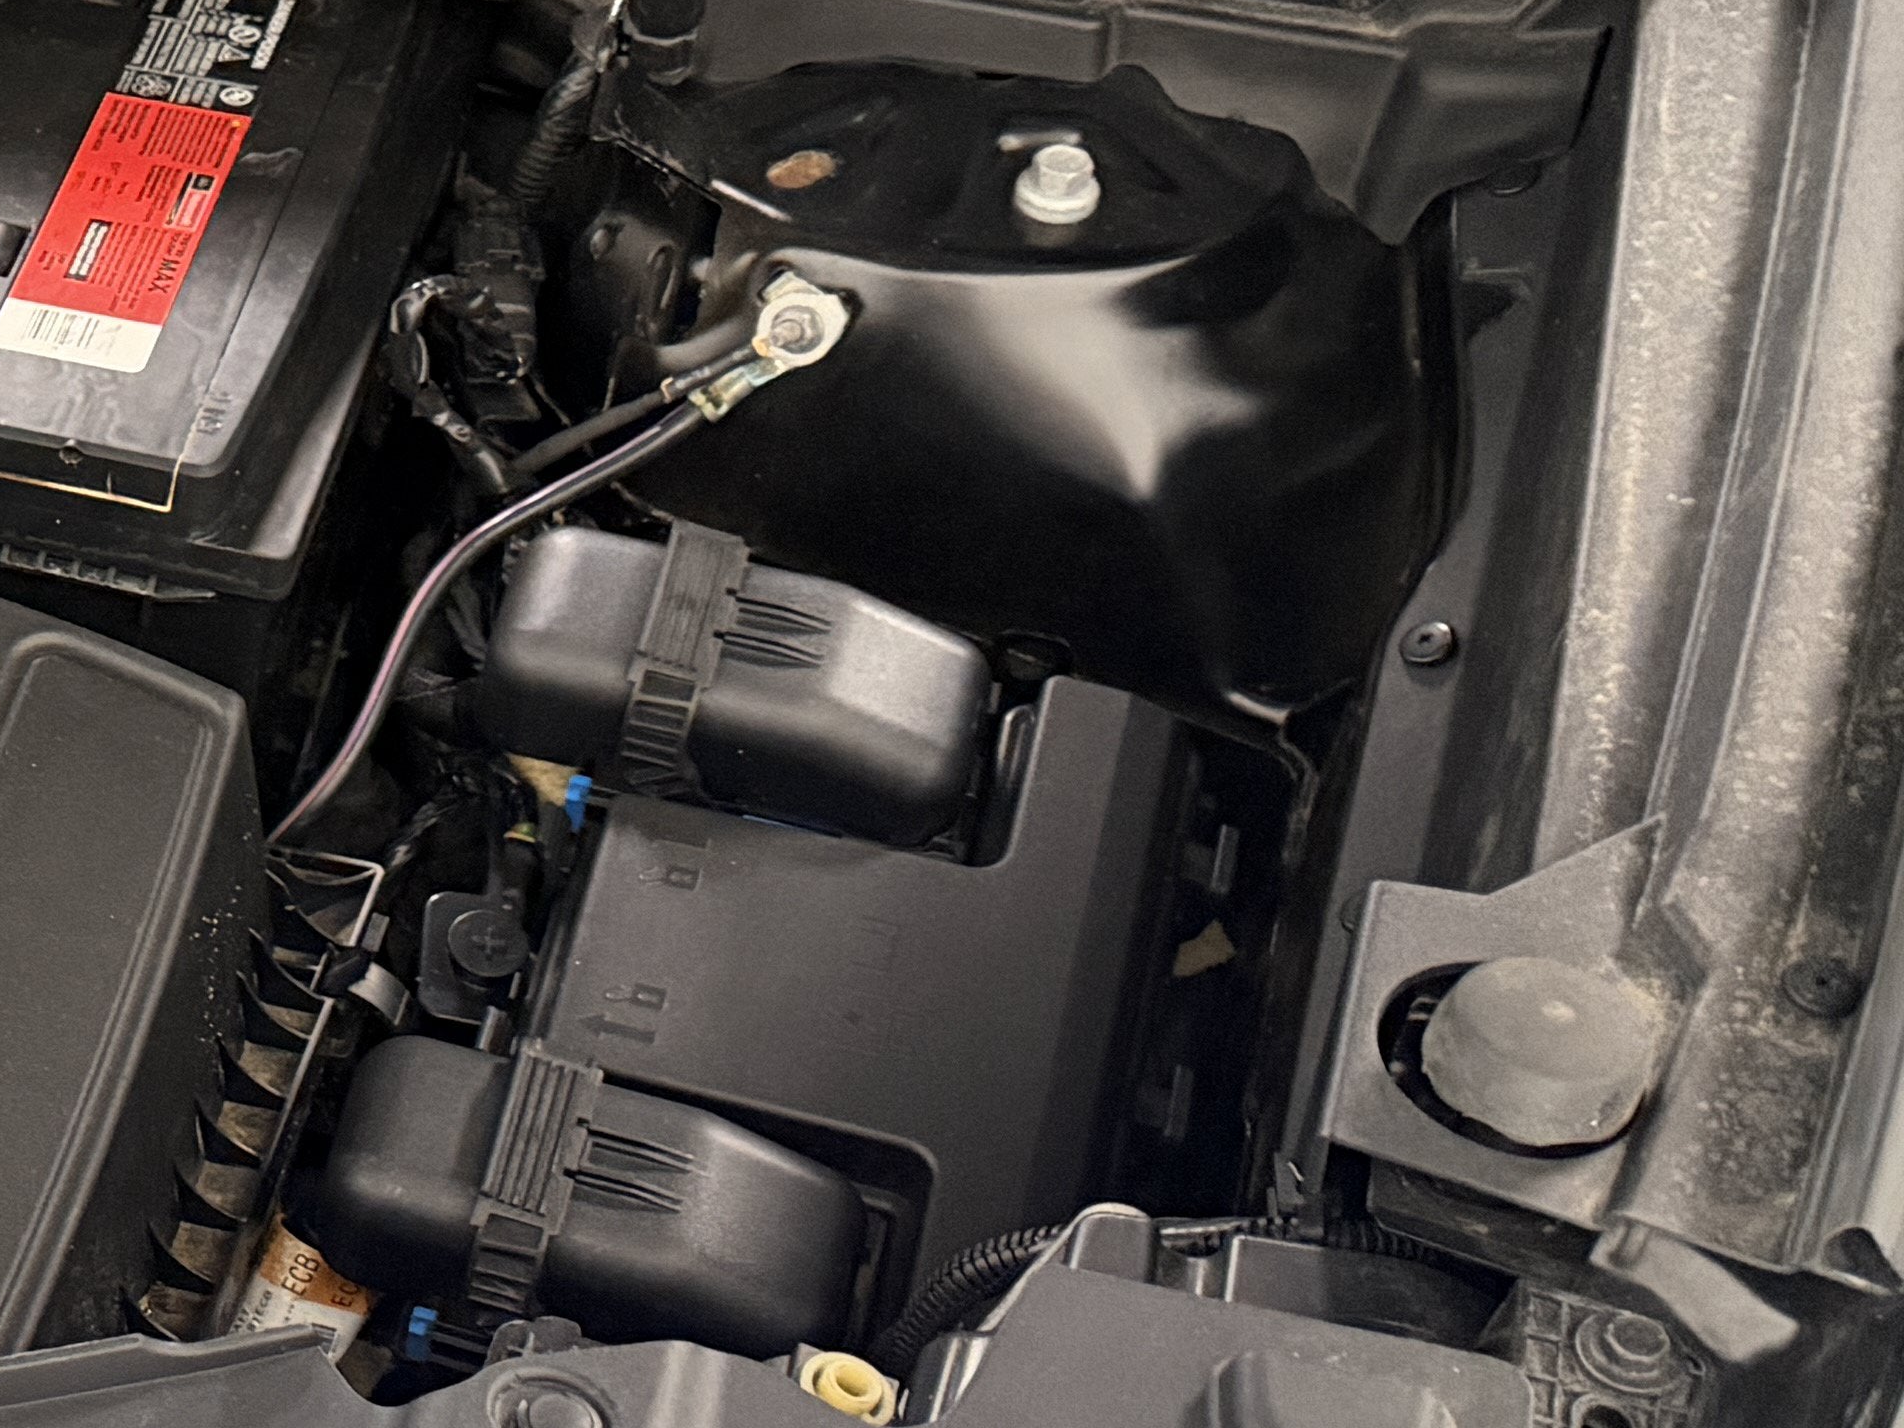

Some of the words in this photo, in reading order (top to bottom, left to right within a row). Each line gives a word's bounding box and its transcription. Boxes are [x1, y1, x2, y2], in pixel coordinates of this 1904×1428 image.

[148, 257, 181, 294] MAX
[281, 1253, 321, 1297] ECB
[330, 1283, 360, 1308] EC
